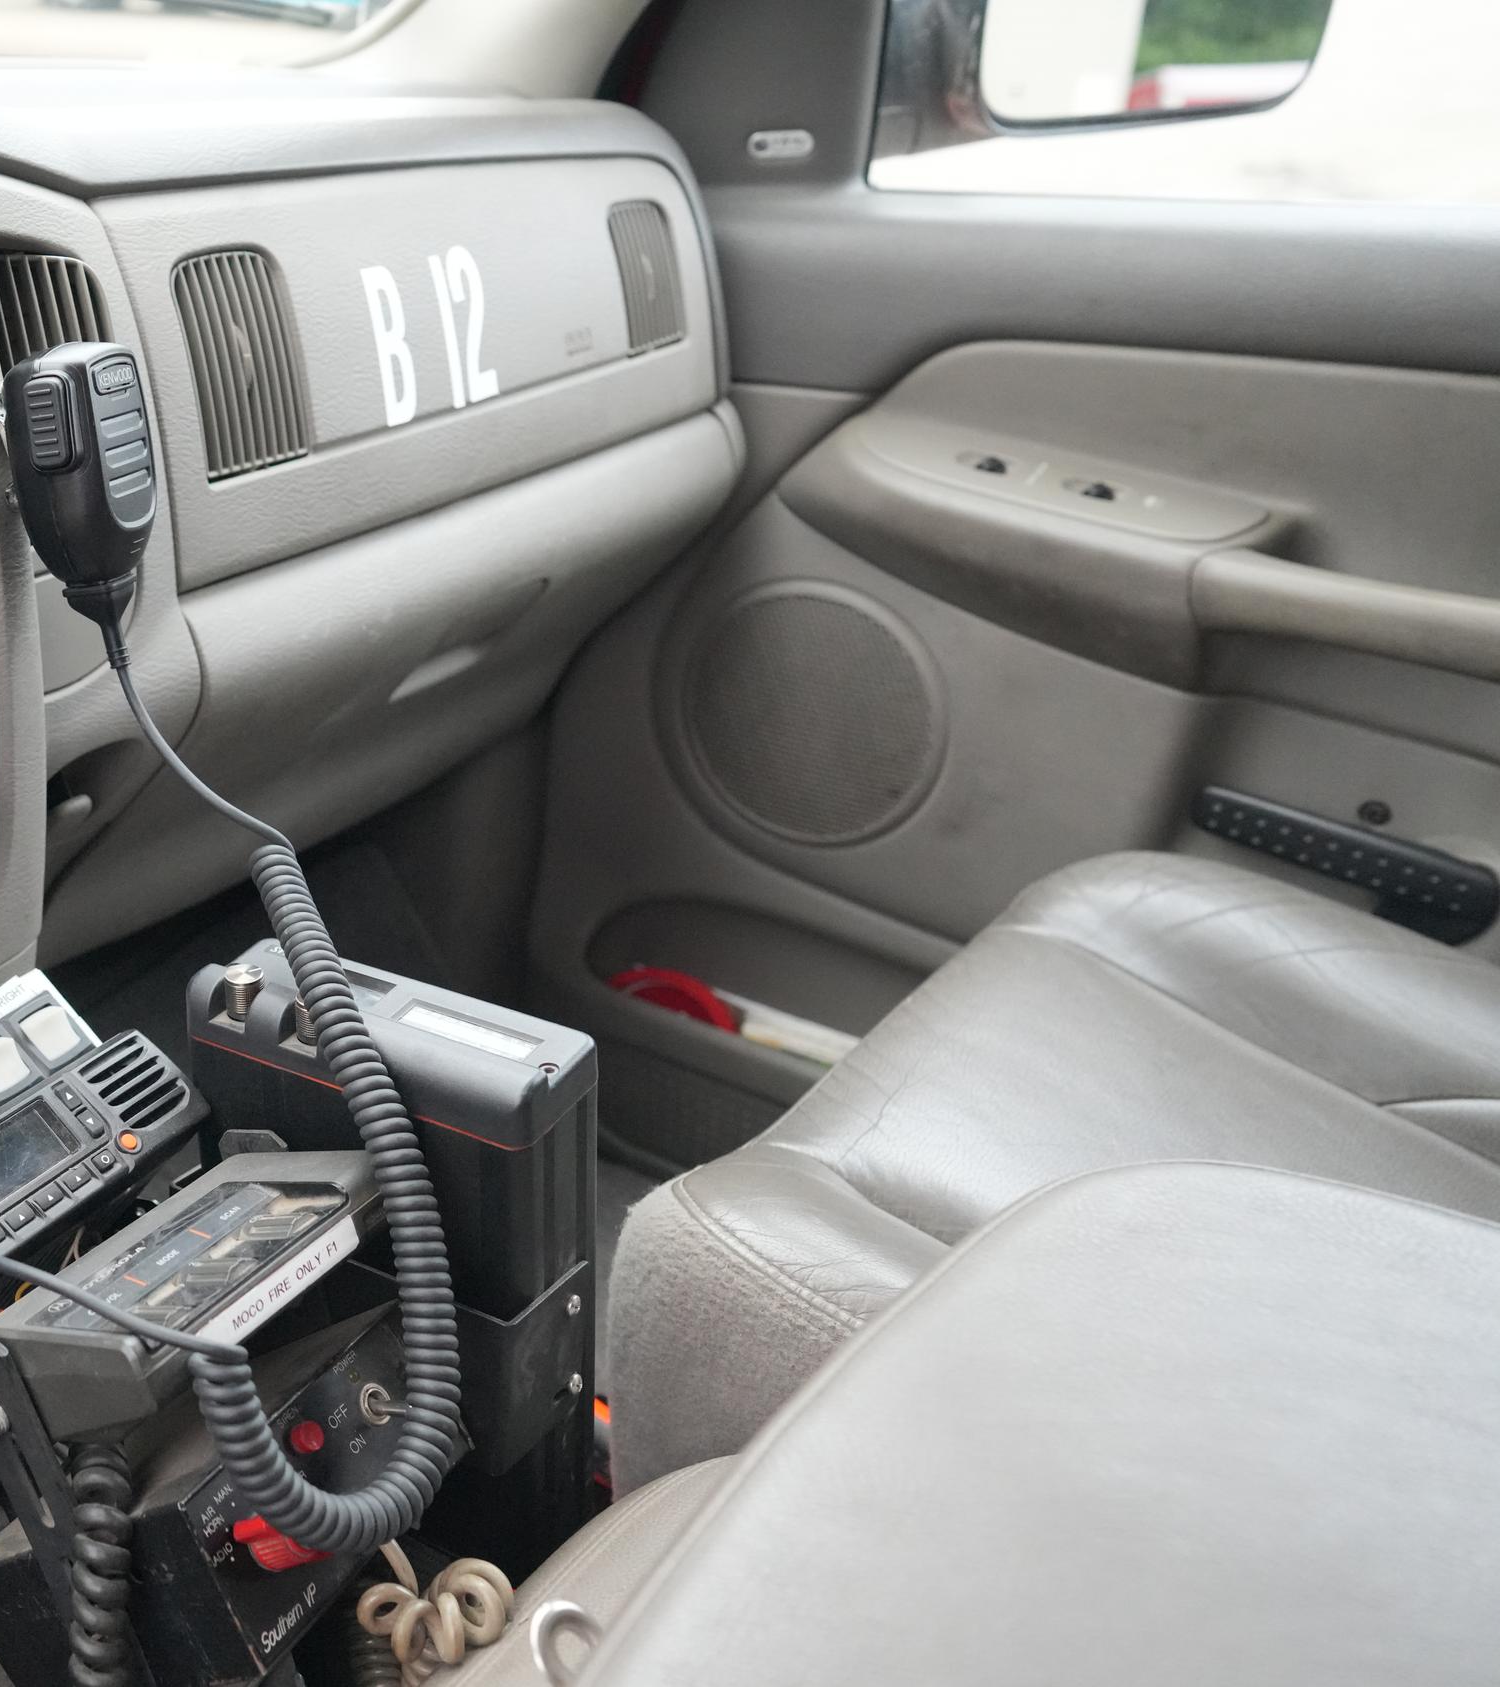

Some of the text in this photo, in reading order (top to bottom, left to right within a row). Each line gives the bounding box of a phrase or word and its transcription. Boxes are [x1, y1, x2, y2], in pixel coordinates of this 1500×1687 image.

[360, 245, 499, 428] B 12
[99, 366, 133, 386] KENWOOD
[220, 1206, 241, 1220] SCAN
[156, 1249, 180, 1266] MODE
[231, 1241, 338, 1330] MOCO FIRE ONLY F1
[332, 1350, 357, 1376] POWER
[276, 1405, 299, 1430] SIREN
[327, 1403, 348, 1429] OFF
[349, 1433, 367, 1454] ON
[213, 1483, 233, 1505] MAN
[201, 1506, 216, 1524] AIR
[202, 1514, 225, 1538] HORN
[211, 1542, 233, 1568] ADIO
[261, 1582, 317, 1654] Southern VP
